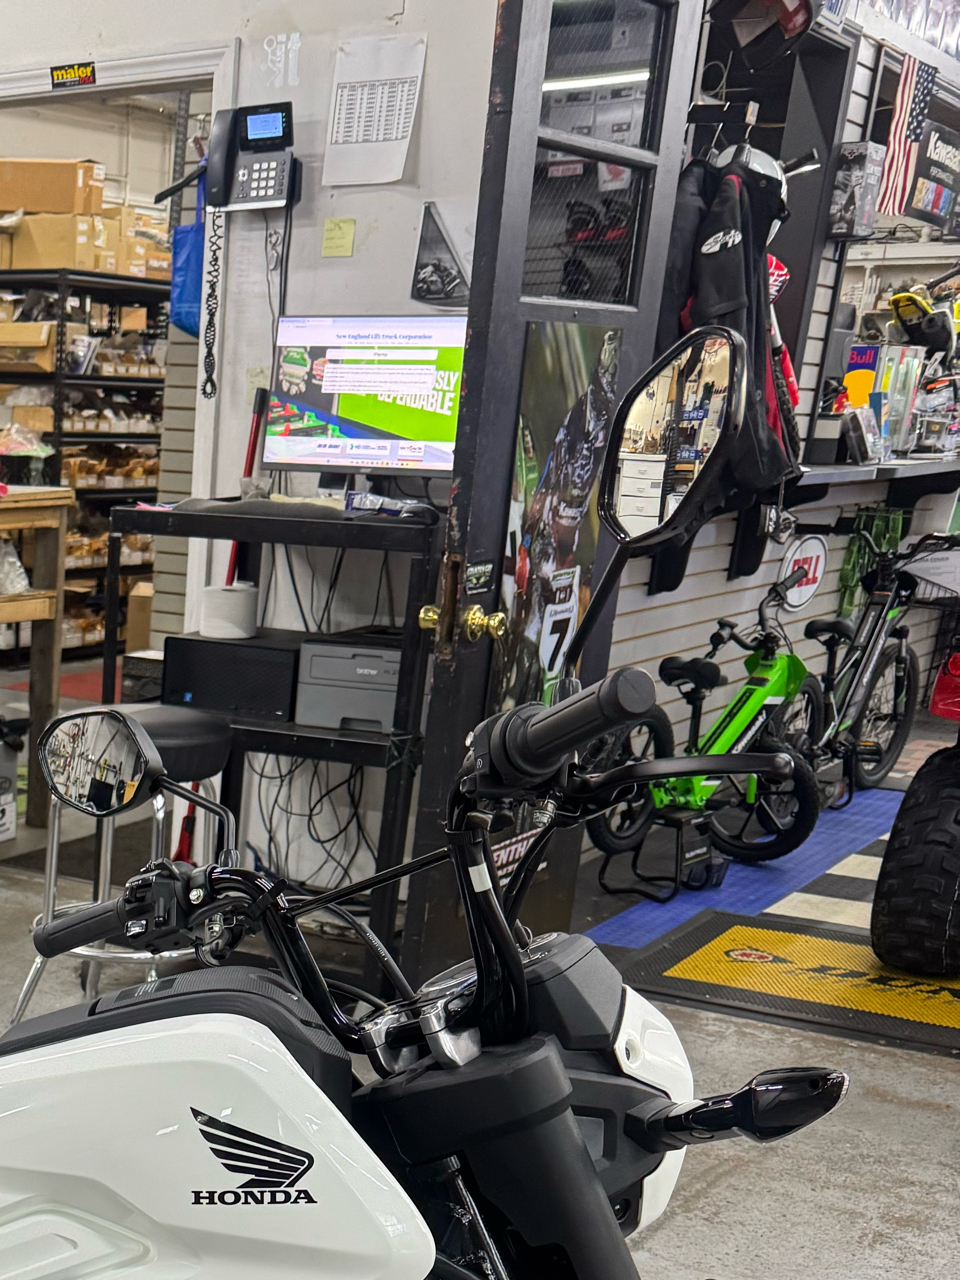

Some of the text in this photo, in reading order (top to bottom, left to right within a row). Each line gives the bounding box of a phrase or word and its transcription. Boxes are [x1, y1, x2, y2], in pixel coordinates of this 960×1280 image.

[848, 350, 875, 363] Bull
[547, 616, 571, 673] 7
[191, 1189, 318, 1205] HONDA
